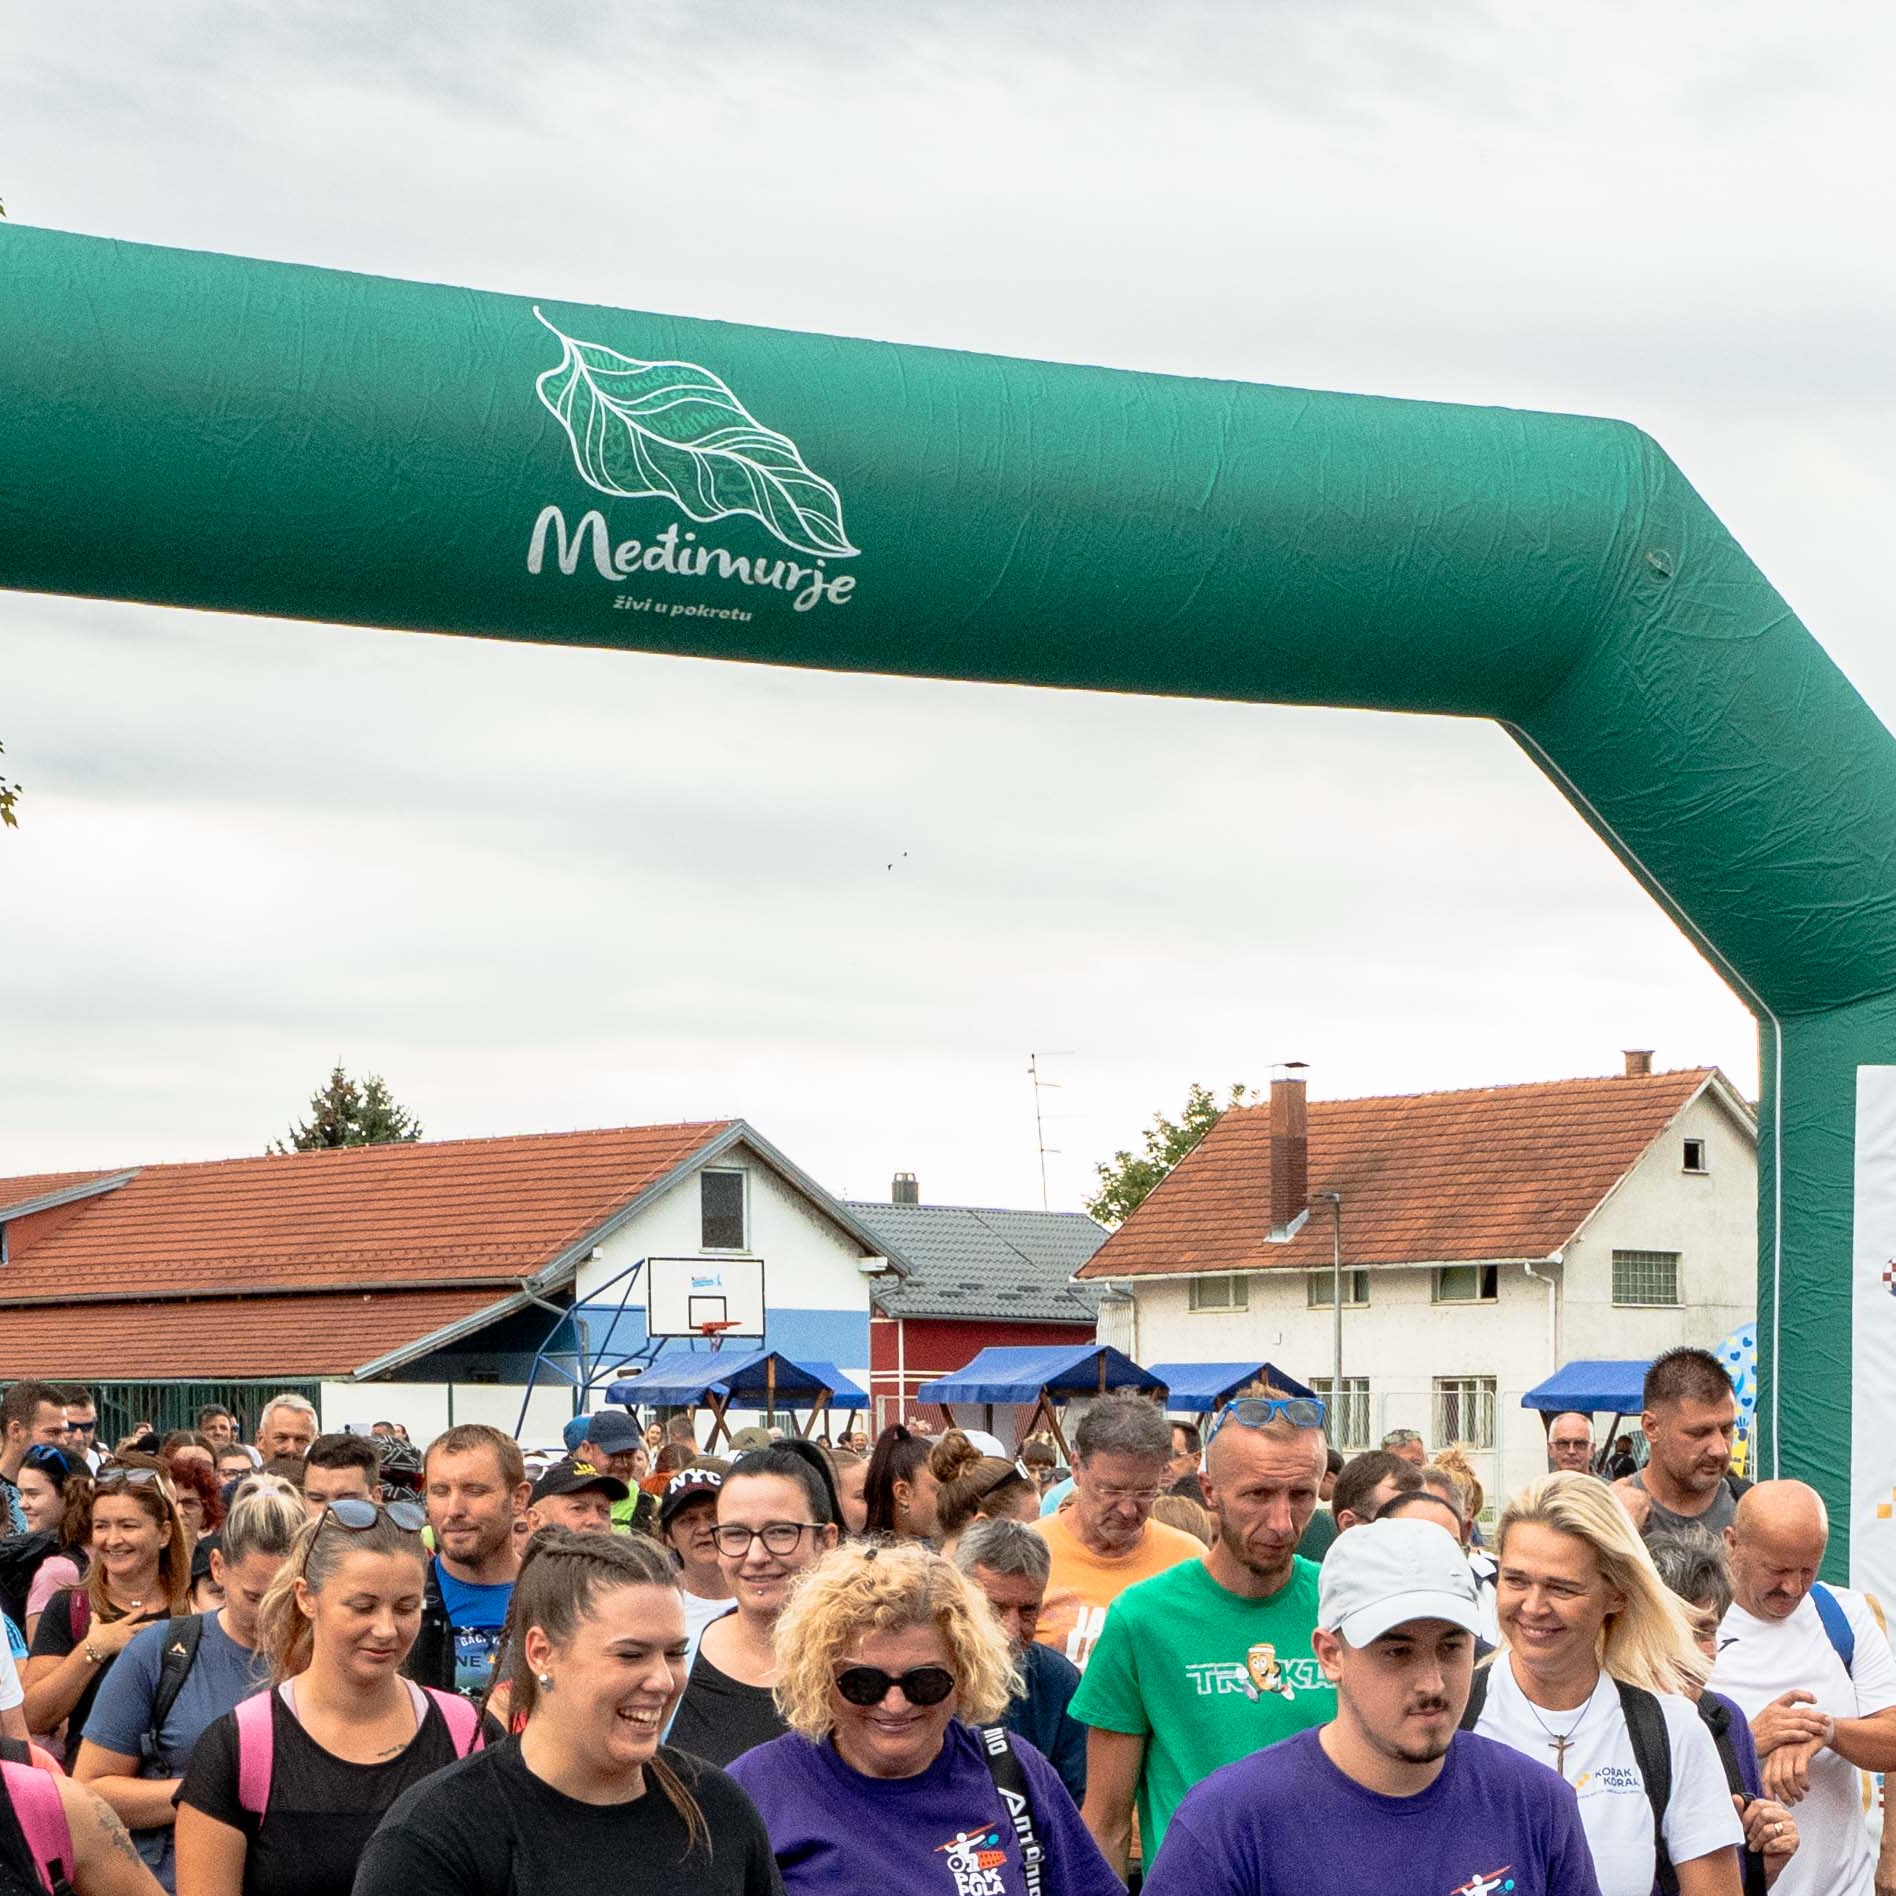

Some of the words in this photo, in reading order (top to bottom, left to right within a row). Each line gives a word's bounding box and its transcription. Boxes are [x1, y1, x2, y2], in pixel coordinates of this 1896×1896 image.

[527, 505, 856, 611] Međimurje
[654, 603, 668, 613] u
[670, 604, 752, 621] pokretu
[669, 1467, 721, 1494] NYC
[953, 1868, 1002, 1884] PAK
[957, 1880, 1006, 1896] PULA
